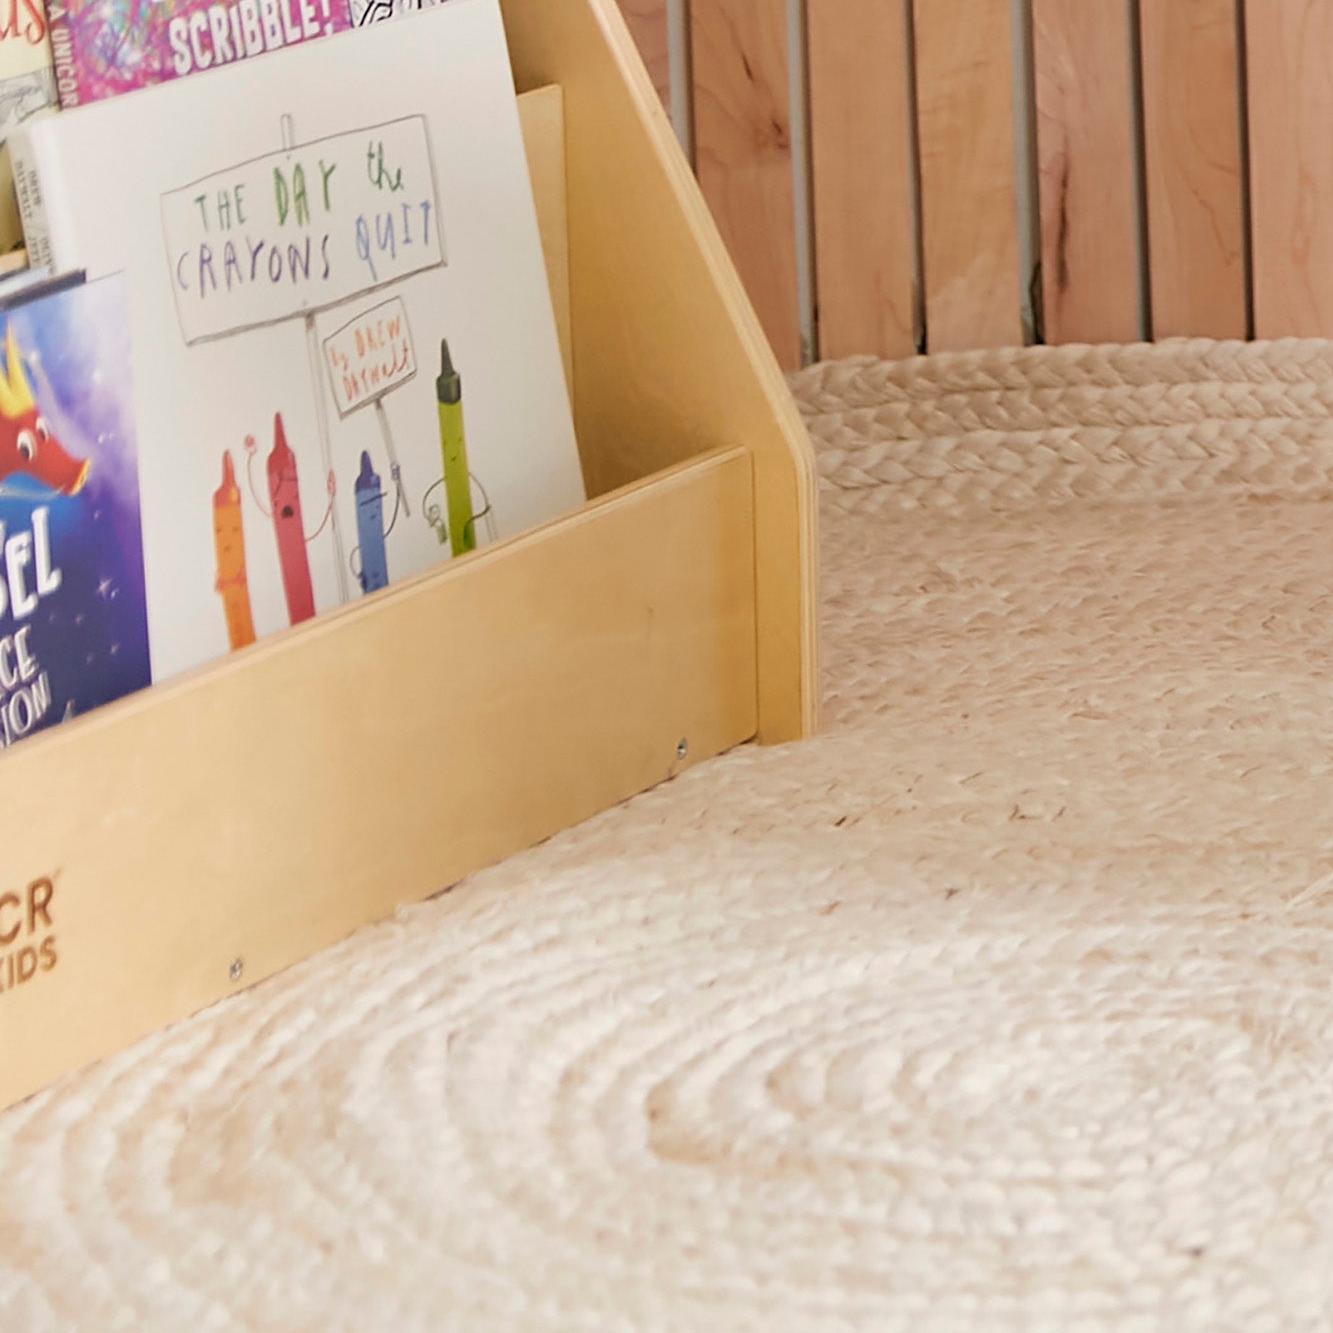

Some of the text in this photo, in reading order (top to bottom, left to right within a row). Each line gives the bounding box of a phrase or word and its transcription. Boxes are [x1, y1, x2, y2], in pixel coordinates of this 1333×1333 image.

[194, 139, 405, 233] THE DAY the
[177, 199, 431, 299] CRAYONS QUIT
[354, 315, 401, 358] DREW
[0, 935, 58, 993] IDS
